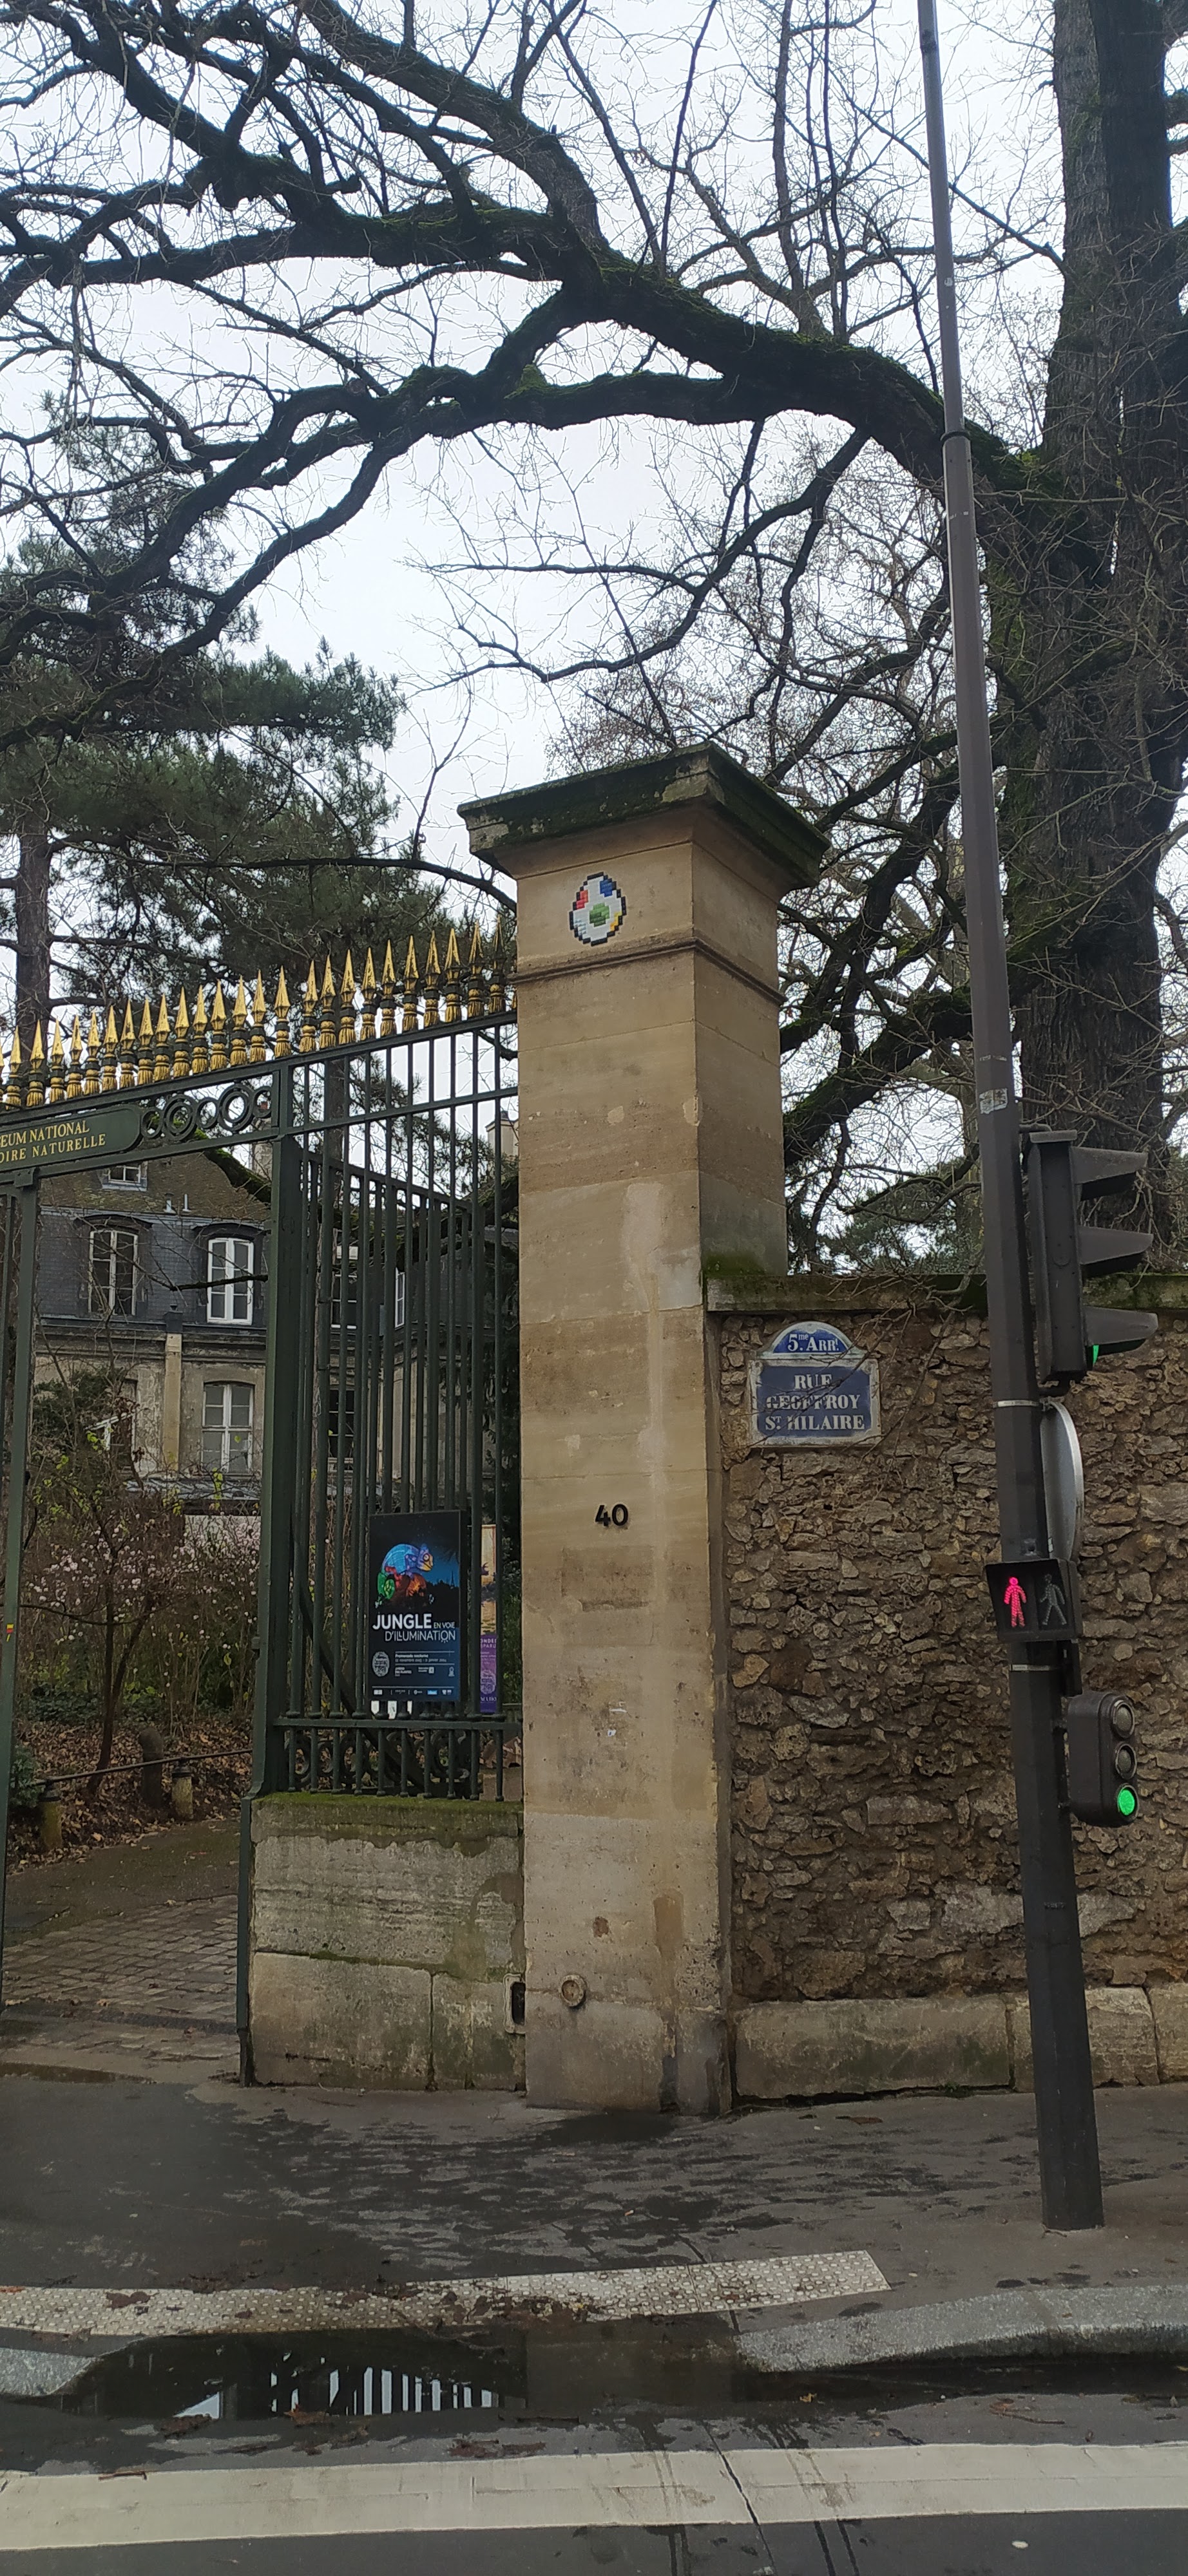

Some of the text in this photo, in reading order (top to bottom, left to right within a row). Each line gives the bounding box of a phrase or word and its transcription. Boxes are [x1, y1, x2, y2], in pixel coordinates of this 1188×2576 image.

[0, 1121, 90, 1148] EUM NATIONAL
[32, 1134, 106, 1158] NATURELLE
[794, 1374, 832, 1390] RUE
[595, 1504, 629, 1527] 40
[372, 1613, 432, 1630] JUNGLE
